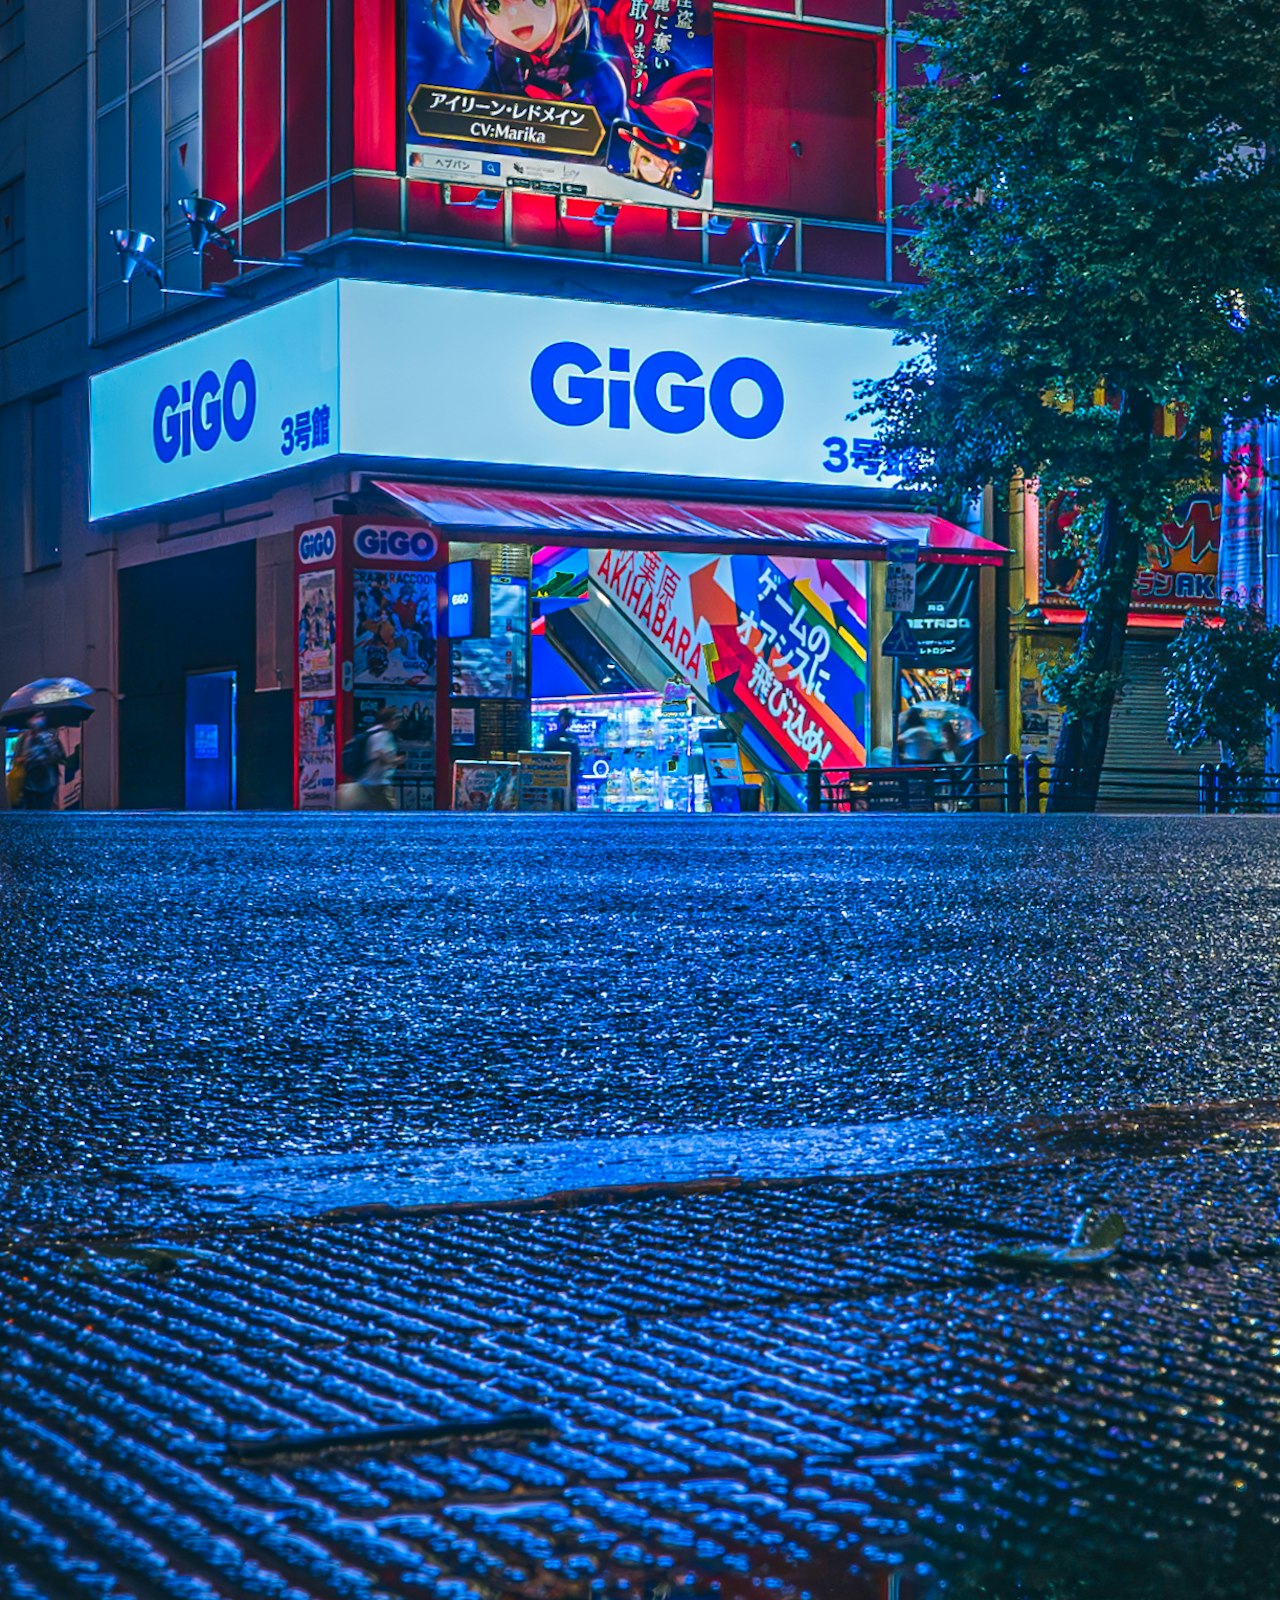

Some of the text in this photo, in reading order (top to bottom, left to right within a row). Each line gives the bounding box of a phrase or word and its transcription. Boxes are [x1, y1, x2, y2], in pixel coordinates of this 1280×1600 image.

[428, 92, 586, 126] アイリーン・レドメイン
[469, 120, 547, 145] CV:Marika
[152, 357, 258, 466] GiGO
[530, 340, 787, 440] GiGO
[280, 402, 331, 457] 3号館
[299, 528, 335, 560] GiGO
[357, 527, 435, 559] GiGO
[596, 548, 702, 680] AKIHABARA
[756, 567, 832, 663] ゲームの
[736, 609, 831, 704] オアシスに
